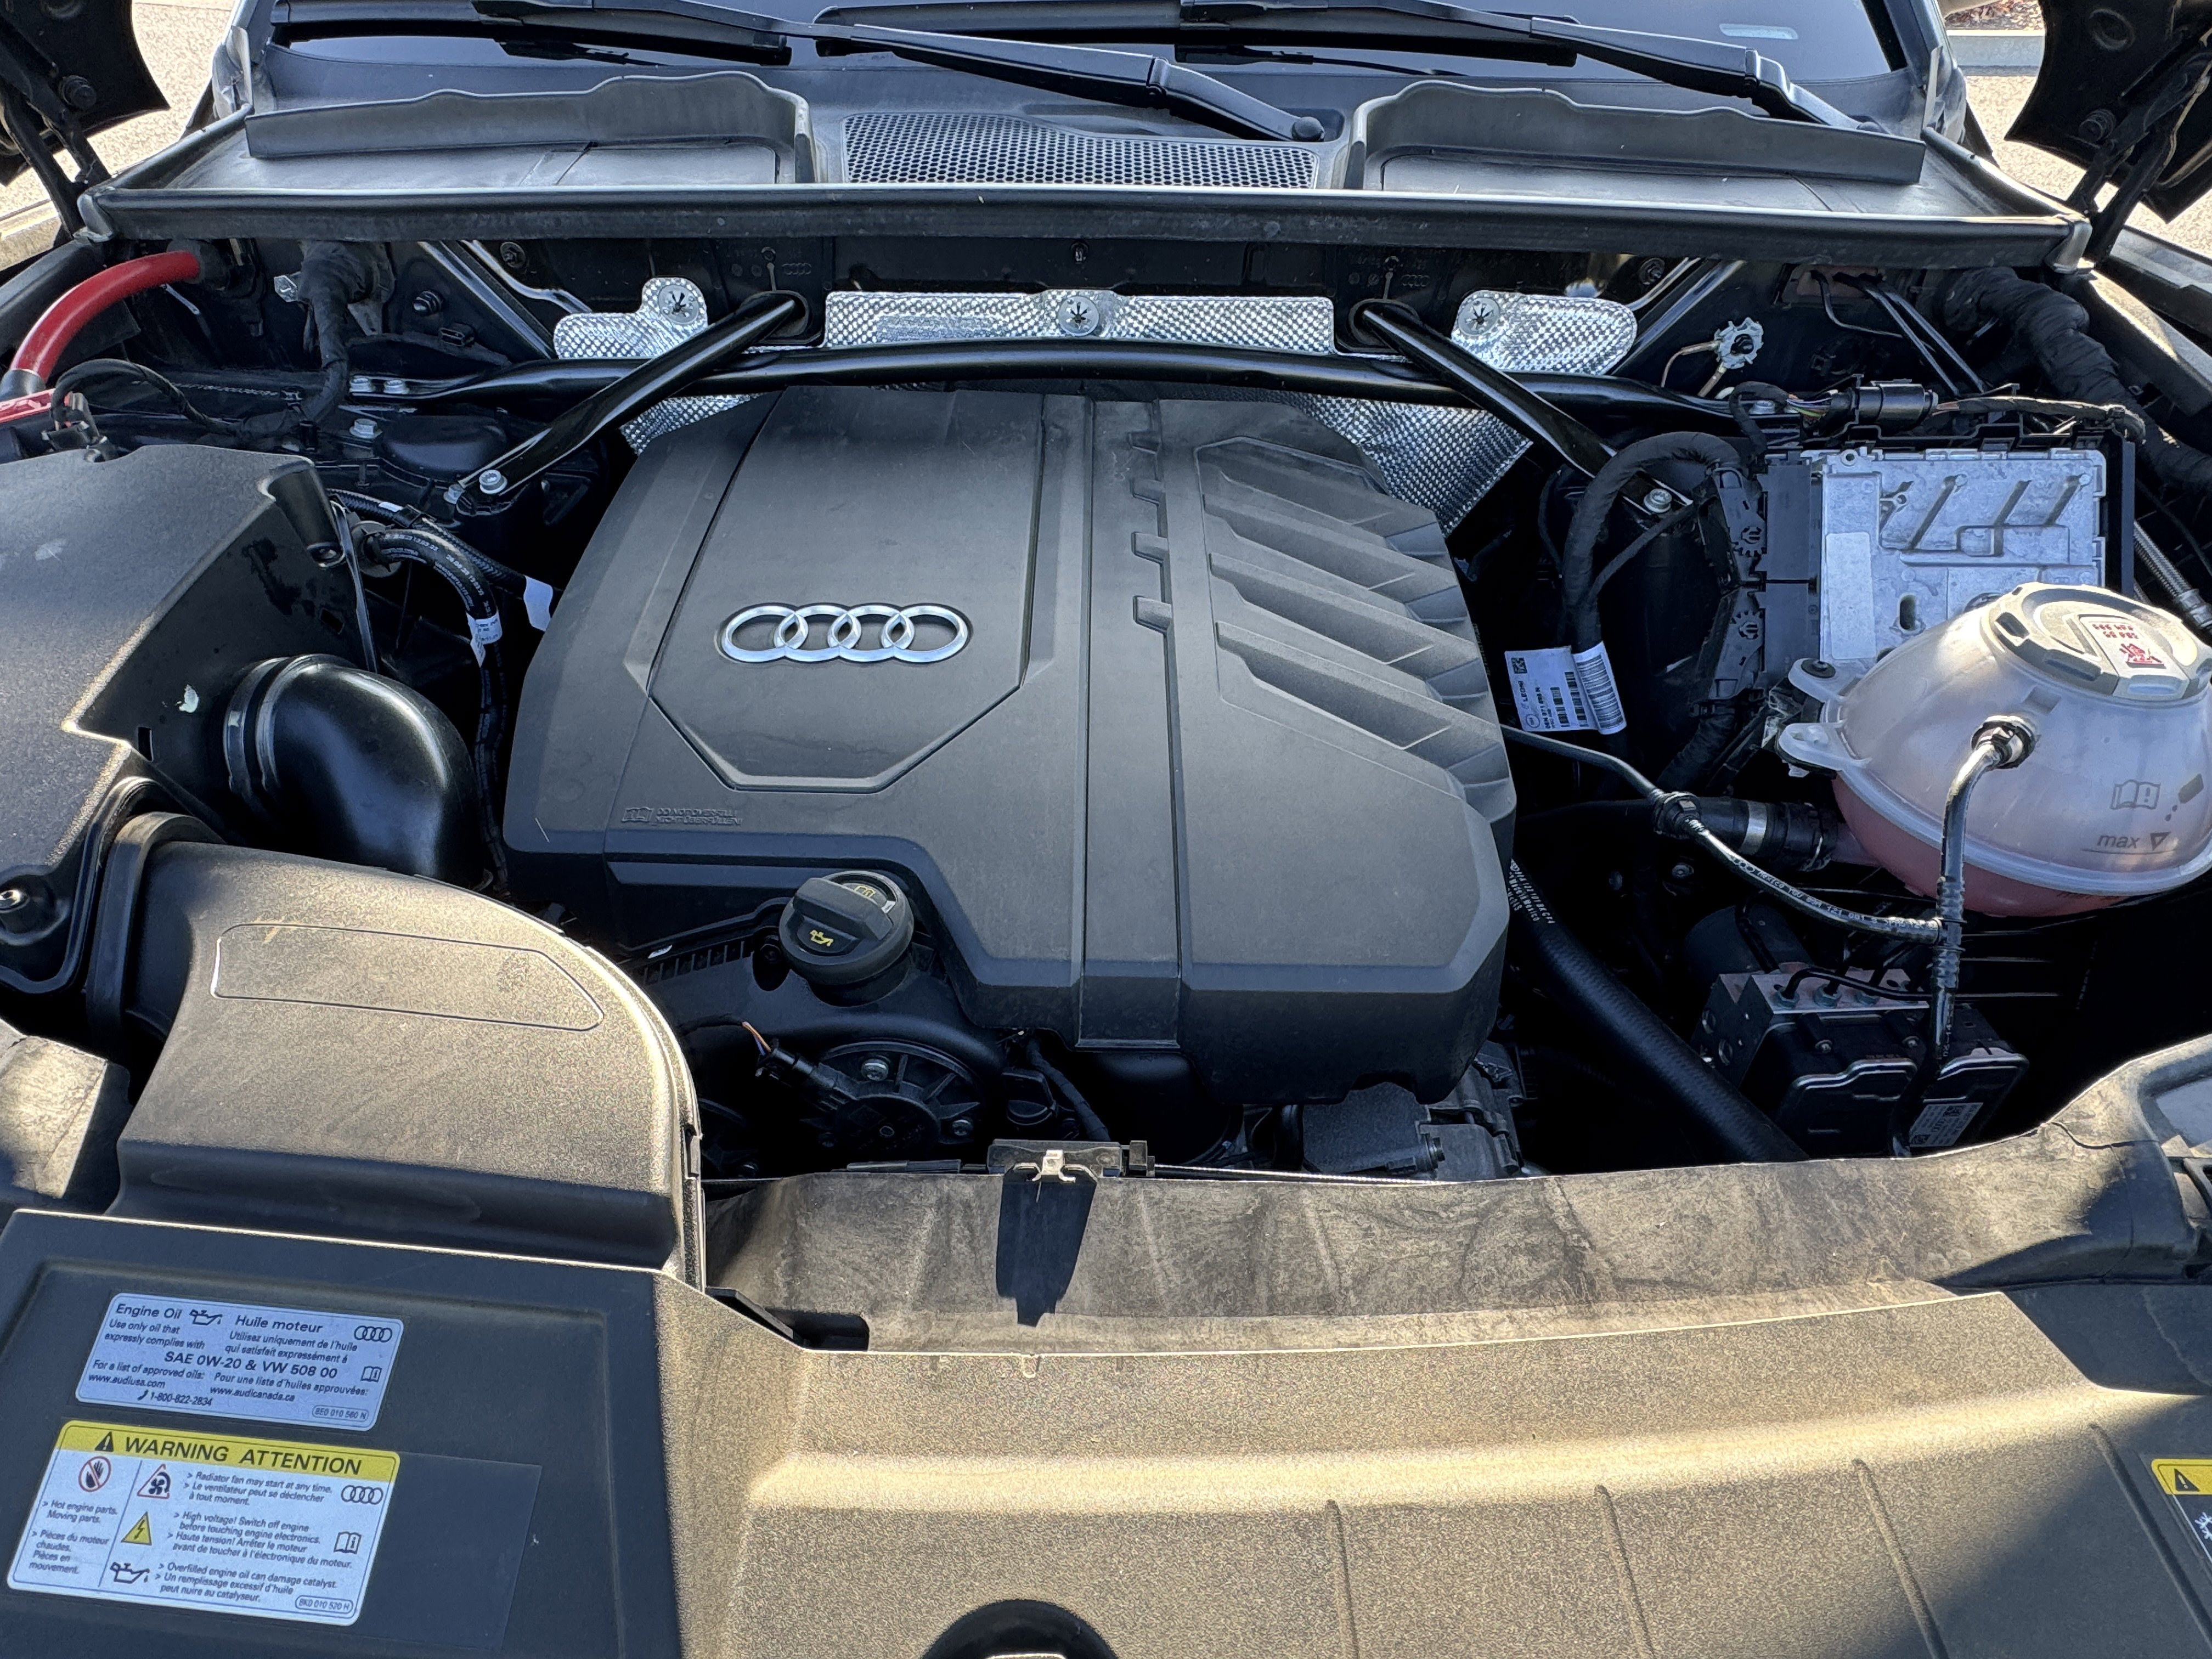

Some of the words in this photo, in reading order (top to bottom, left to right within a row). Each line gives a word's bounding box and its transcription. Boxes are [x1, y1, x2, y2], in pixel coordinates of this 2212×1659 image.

[2097, 834, 2140, 848] max
[116, 1304, 160, 1317] Engine
[164, 1308, 183, 1319] Oil
[109, 1319, 125, 1329] Use
[128, 1322, 147, 1333] only
[149, 1323, 161, 1332] oil
[162, 1324, 180, 1334] that
[235, 1314, 268, 1328] Huile
[272, 1321, 323, 1333] moteur
[104, 1334, 145, 1345] expressly
[146, 1336, 184, 1348] complies
[187, 1340, 205, 1350] with
[229, 1330, 260, 1342] Utilisez
[263, 1336, 315, 1348] uniquement
[317, 1339, 329, 1349] de
[225, 1344, 240, 1354] qui
[241, 1346, 276, 1357] satisfait
[278, 1350, 341, 1363] expressément
[93, 1359, 108, 1369] For
[116, 1362, 130, 1372] list
[132, 1364, 143, 1373] of
[143, 1367, 185, 1378] approved
[165, 1351, 194, 1364] SAE
[197, 1355, 241, 1369] 0W-20
[245, 1359, 257, 1370] &
[263, 1361, 289, 1373] VW
[290, 1365, 317, 1376] 508
[320, 1367, 337, 1379] 00
[88, 1374, 166, 1389] www.audiusa.com
[214, 1372, 236, 1383] Pour
[237, 1375, 253, 1384] une
[256, 1376, 274, 1387] liste
[150, 1391, 213, 1406] 1-800-822-2834
[210, 1386, 295, 1402] www.audicanada.ca
[330, 1409, 344, 1417] 010
[125, 1437, 229, 1462] WARNING
[239, 1449, 362, 1475] ATTENTION
[192, 1482, 202, 1490] Le
[204, 1483, 247, 1494] ventilateur
[247, 1487, 267, 1497] peut
[195, 1471, 230, 1482] Radiator
[231, 1475, 244, 1483] fan
[246, 1478, 263, 1487] may
[265, 1480, 284, 1488] start
[295, 1482, 310, 1492] any
[312, 1483, 332, 1493] time.
[196, 1492, 213, 1502] tout
[215, 1495, 250, 1505] moment.
[51, 1499, 66, 1509] Hot
[67, 1503, 94, 1513] engine
[95, 1506, 118, 1515] parts.
[47, 1509, 77, 1522] Moving
[78, 1514, 100, 1523] parts.
[183, 1511, 201, 1522] High
[204, 1515, 238, 1525] voltage!
[239, 1516, 266, 1528] Switch
[268, 1520, 281, 1529] off
[281, 1522, 309, 1533] engine
[67, 1532, 77, 1542] du
[80, 1536, 109, 1545] moteur
[179, 1522, 206, 1532] before
[208, 1525, 242, 1537] touching
[245, 1528, 273, 1539] engine
[274, 1531, 320, 1544] electronics.
[36, 1540, 71, 1551] chaudes.
[176, 1531, 200, 1542] Haute
[202, 1534, 235, 1545] tension!
[267, 1540, 275, 1549] le
[276, 1543, 308, 1553] moteur
[172, 1543, 196, 1552] avant
[197, 1544, 208, 1553] de
[210, 1545, 240, 1557] toucher
[307, 1555, 318, 1565] du
[320, 1559, 352, 1568] moteur.
[29, 1562, 80, 1574] mouvement.
[167, 1561, 207, 1575] Overfilled
[209, 1566, 237, 1578] engine
[239, 1570, 250, 1580] oil
[251, 1572, 266, 1581] can
[268, 1573, 301, 1585] damage
[303, 1578, 337, 1589] catalyst.
[164, 1572, 177, 1582] Un
[178, 1574, 228, 1588] remplissage
[230, 1580, 264, 1592] excessif
[160, 1584, 179, 1593] peut
[181, 1585, 202, 1596] nuire
[204, 1589, 215, 1598] au
[216, 1589, 261, 1602] catalyseur.
